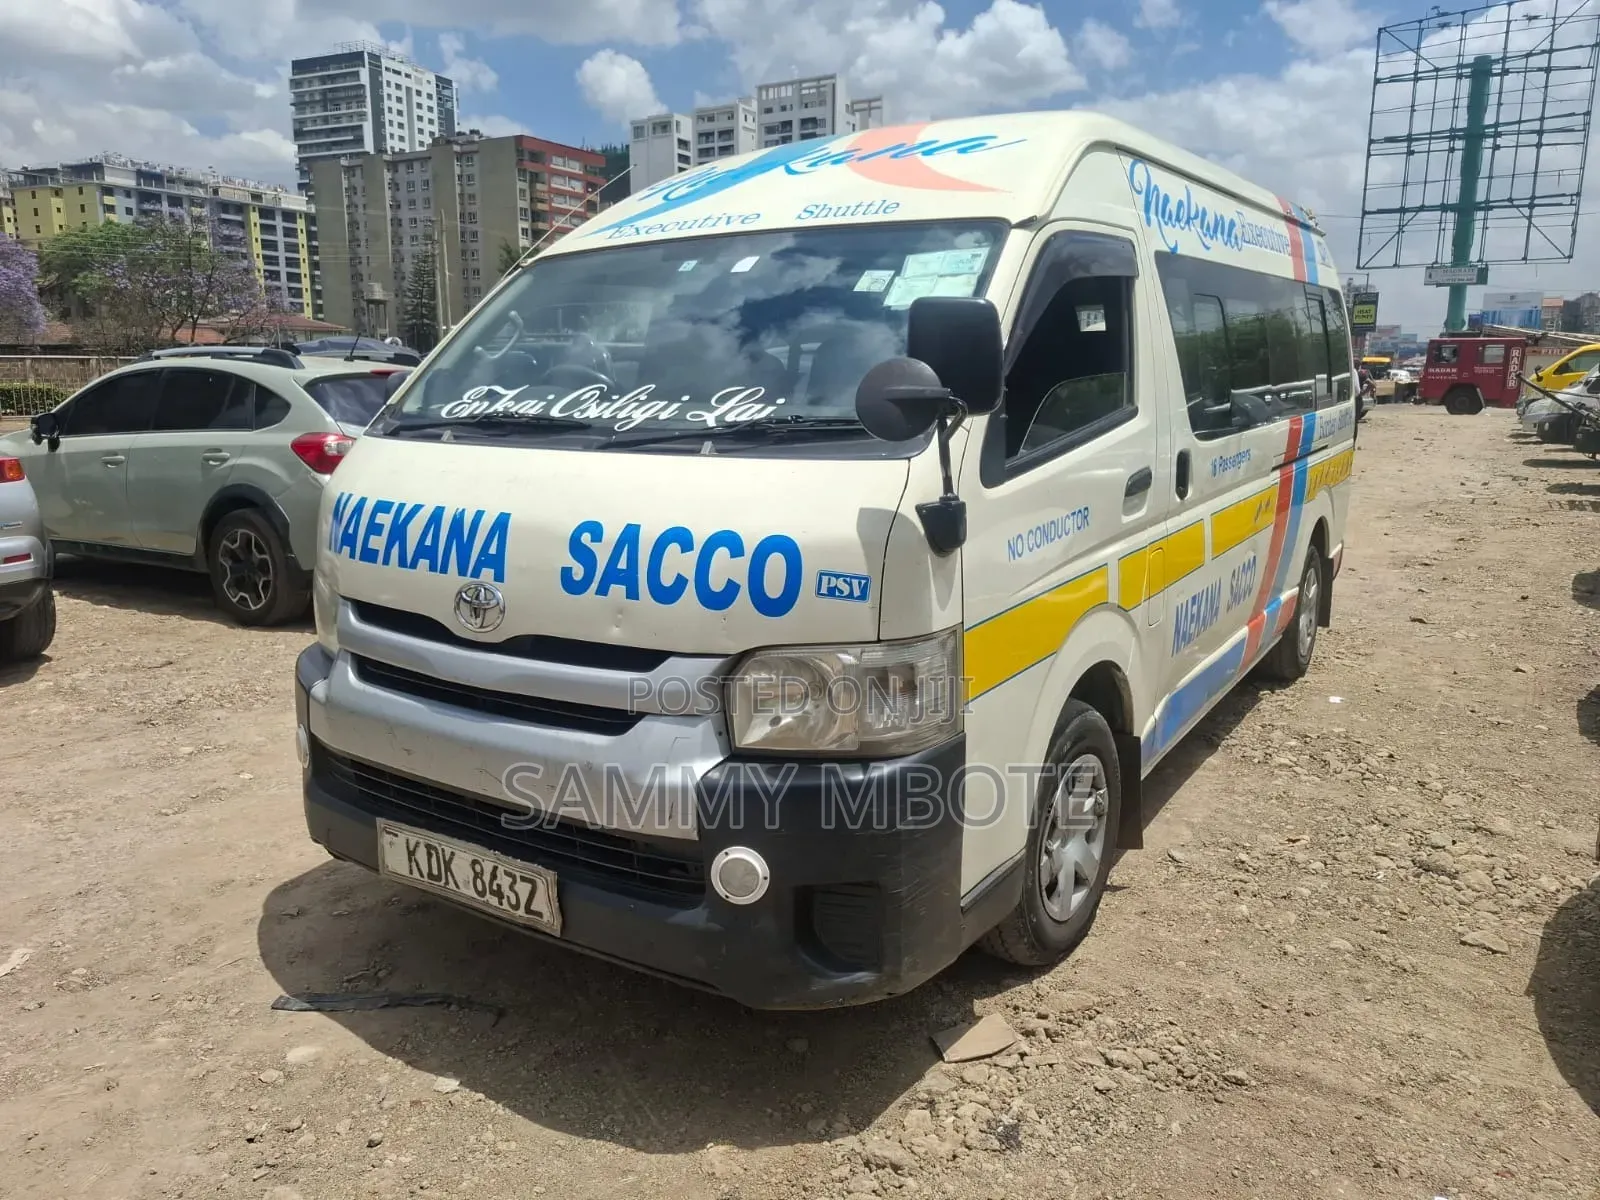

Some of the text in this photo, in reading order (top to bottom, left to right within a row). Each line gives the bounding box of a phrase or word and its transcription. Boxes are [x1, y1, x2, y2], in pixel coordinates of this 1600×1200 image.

[605, 199, 900, 240] Executive Shuttle
[1507, 348, 1521, 388] RADAR
[1218, 448, 1252, 473] Passengers
[329, 491, 803, 618] NAEKANA SACCO
[1007, 506, 1090, 562] NO CONDUCTOR
[819, 575, 867, 598] PSV
[1171, 555, 1257, 657] NAEKANA SACCO
[405, 838, 544, 920] KDK 843Z
